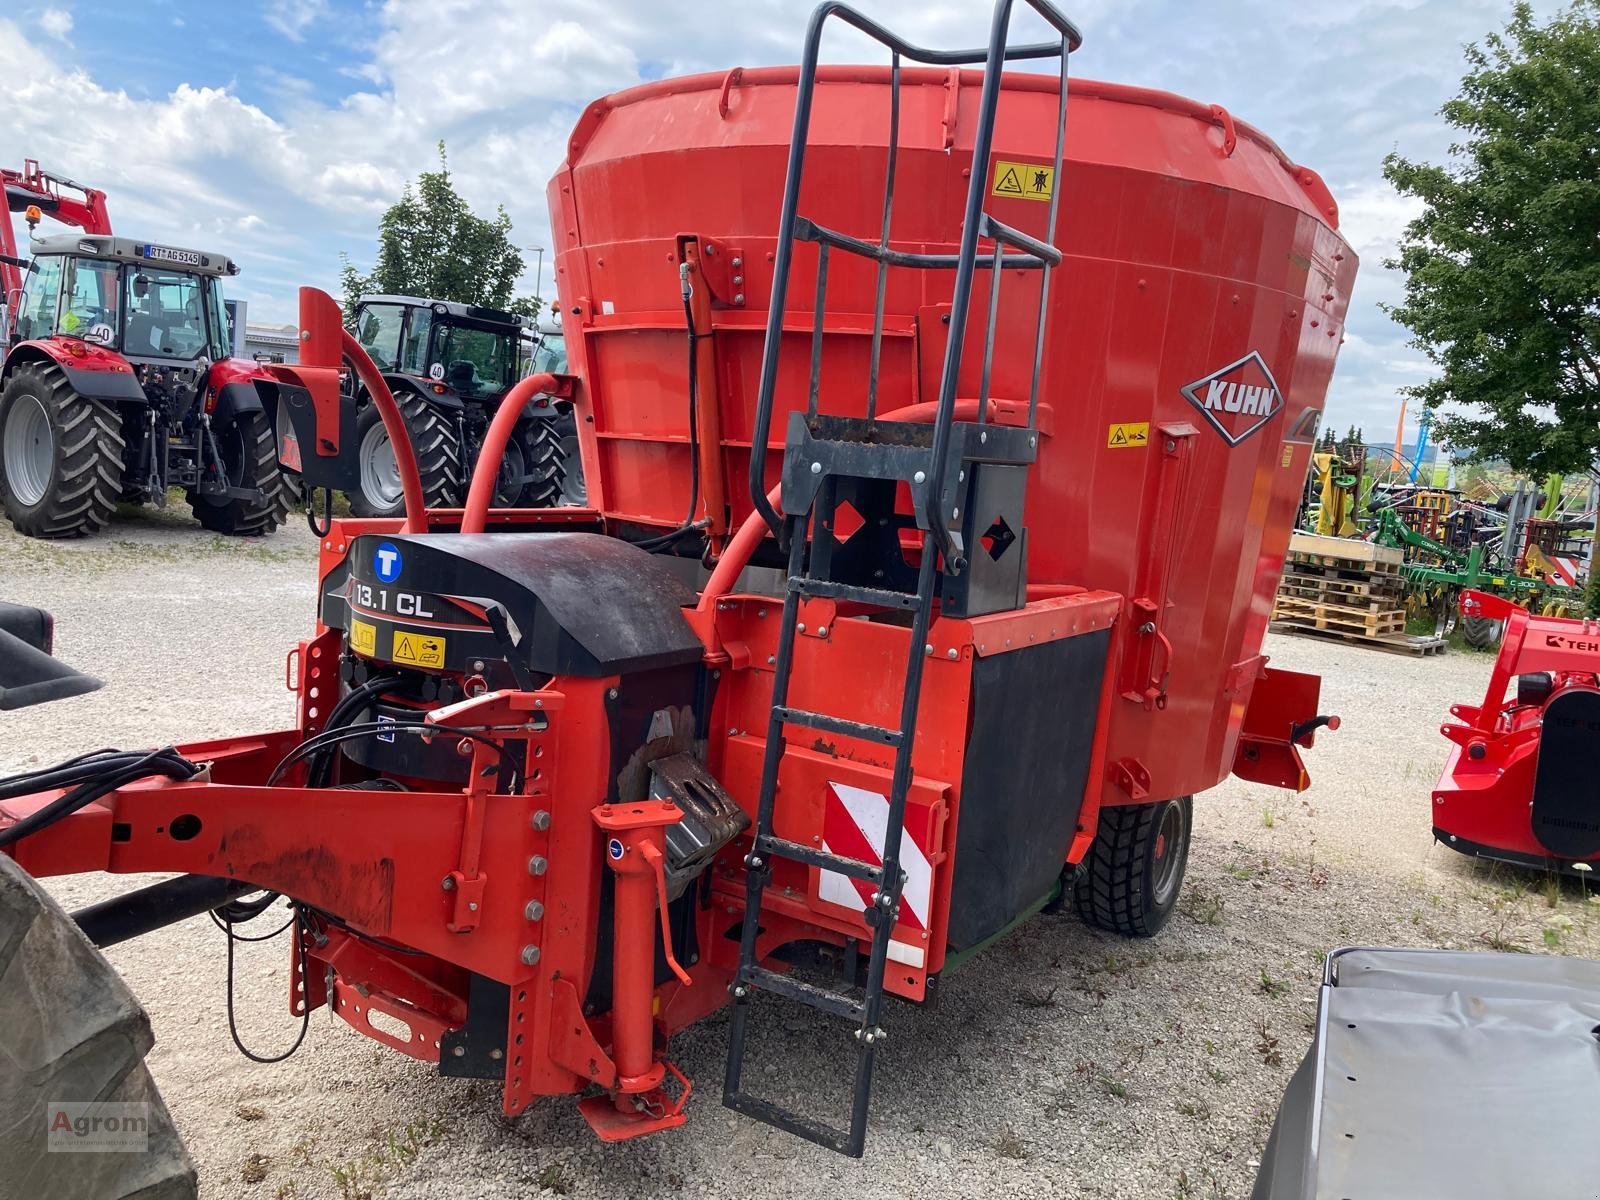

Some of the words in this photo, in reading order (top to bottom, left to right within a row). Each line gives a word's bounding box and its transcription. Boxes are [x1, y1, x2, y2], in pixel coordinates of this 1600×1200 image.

[151, 247, 161, 257] RT
[167, 250, 177, 261] AG
[179, 252, 198, 264] 5145
[432, 365, 441, 378] 40
[1204, 379, 1275, 417] KUHN
[378, 549, 398, 576] T
[357, 584, 387, 611] 13.1
[396, 593, 433, 618] CL
